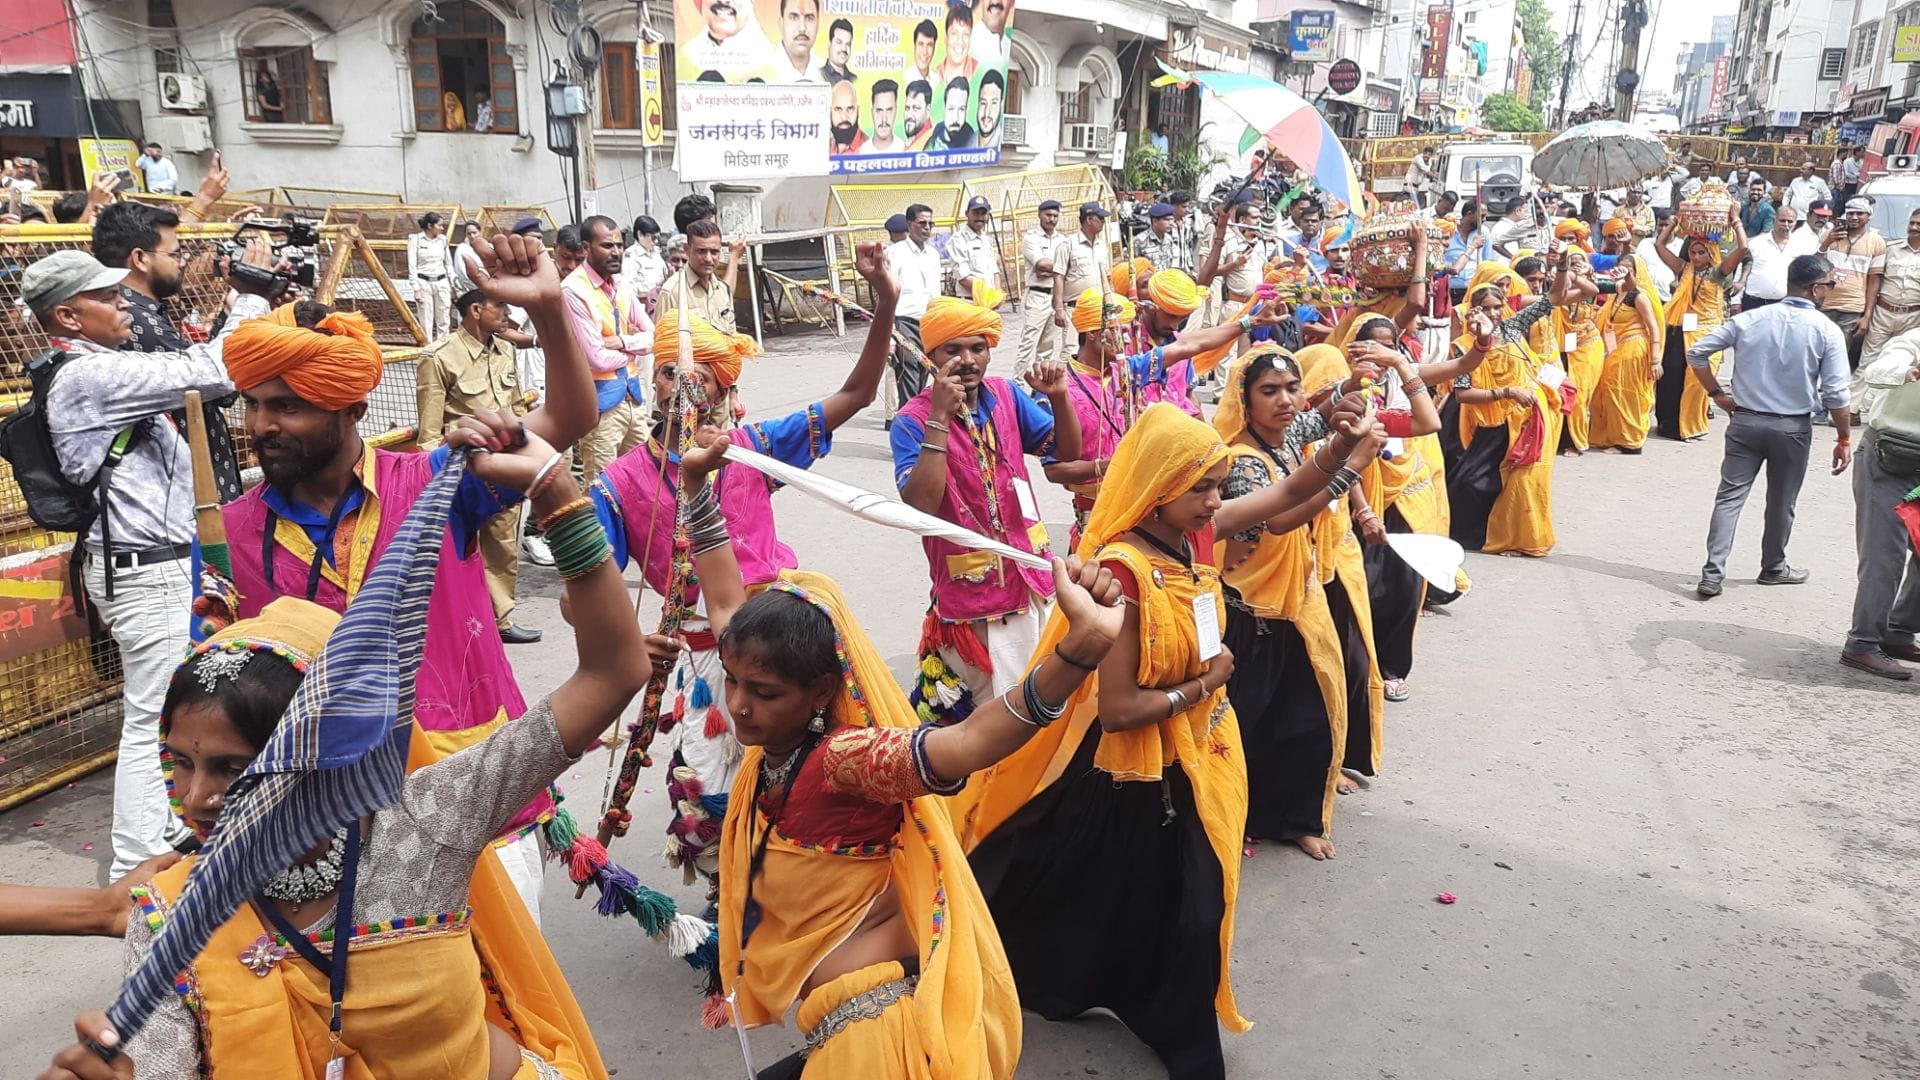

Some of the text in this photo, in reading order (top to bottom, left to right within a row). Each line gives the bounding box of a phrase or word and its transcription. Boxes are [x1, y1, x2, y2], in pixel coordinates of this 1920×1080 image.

[1427, 13, 1446, 77] ELITE
[688, 119, 820, 141] जनसंपर्क विभाग
[764, 153, 789, 169] समूह
[843, 157, 913, 172] पहलवान
